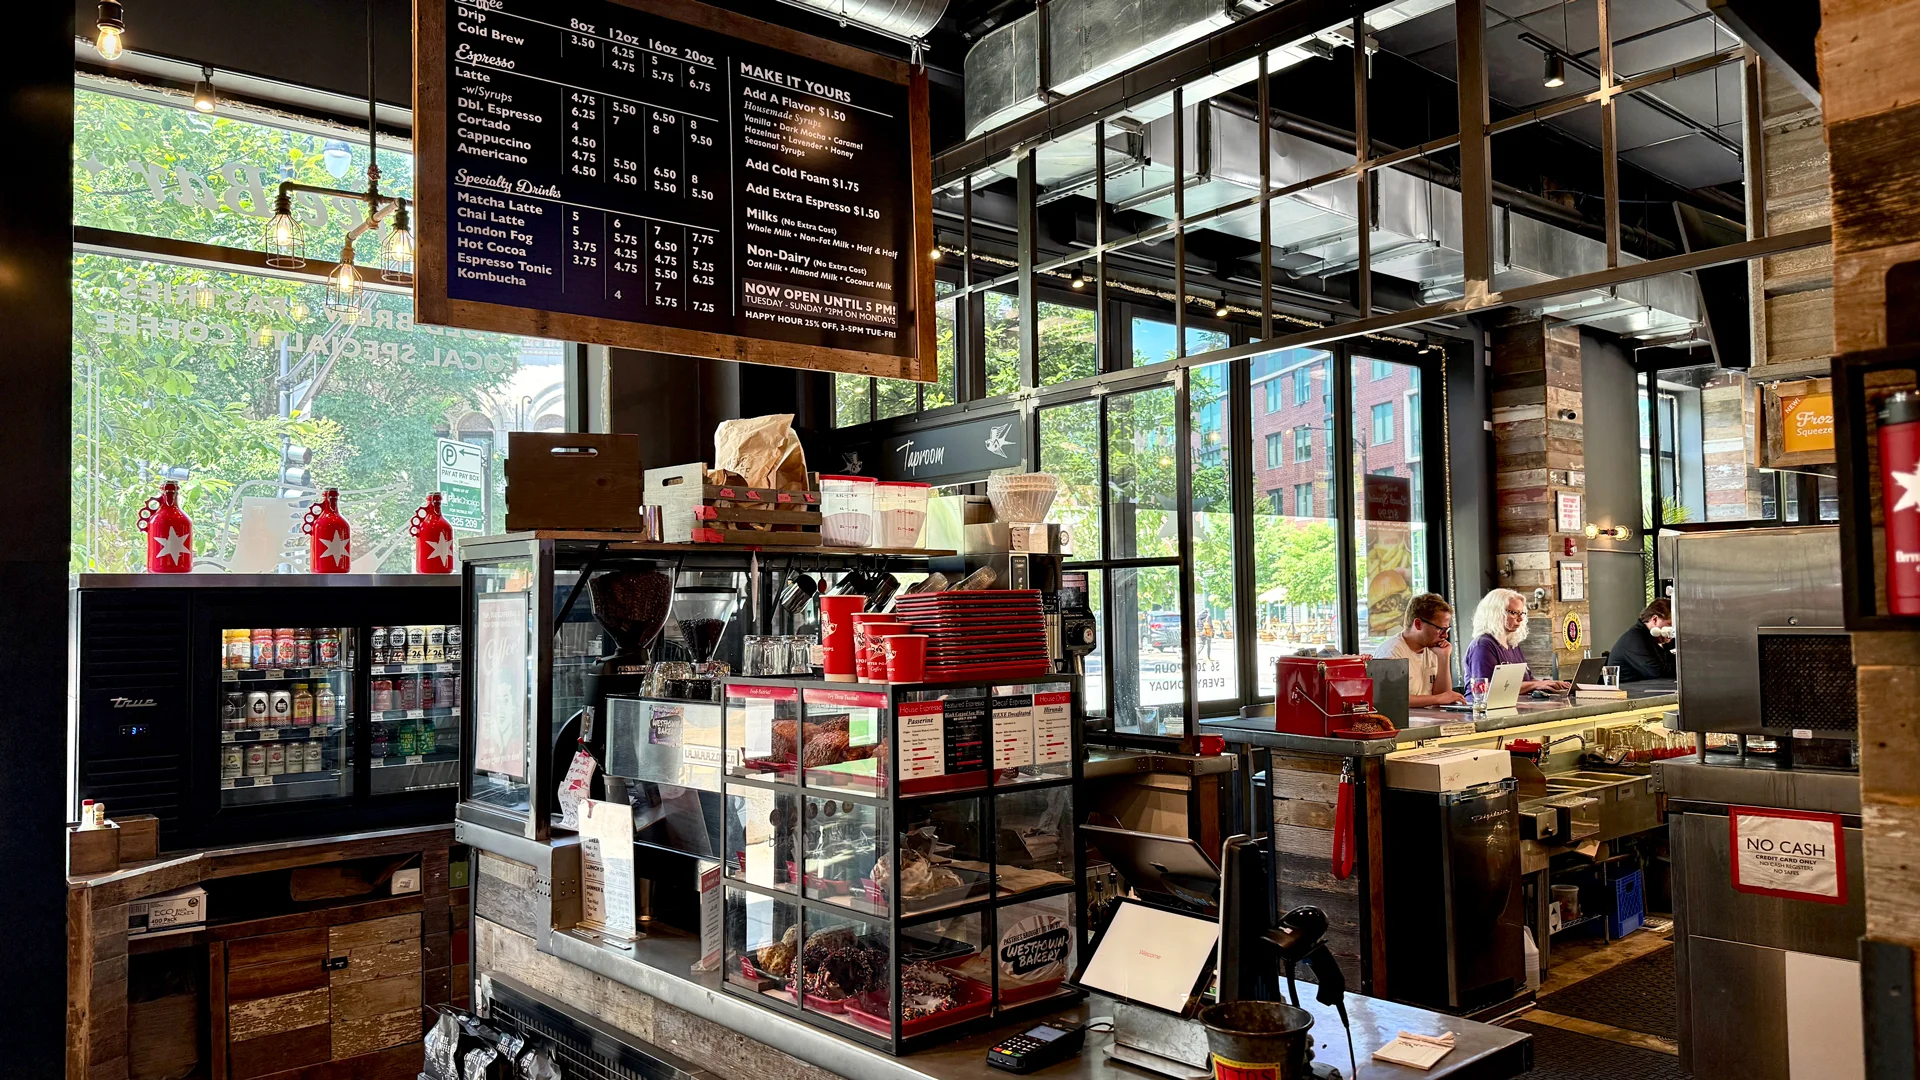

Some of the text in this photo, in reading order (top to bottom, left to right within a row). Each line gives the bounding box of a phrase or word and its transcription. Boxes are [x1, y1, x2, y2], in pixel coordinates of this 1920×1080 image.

[458, 6, 486, 23] Drip
[457, 21, 524, 45] Cold Brew
[570, 17, 714, 65] 8oz 12oz 16oz 20oz
[455, 43, 514, 70] Espresso
[455, 66, 490, 82] Latte
[740, 62, 850, 102] MAKE IT YOURS
[461, 85, 512, 103] -w/Syrups
[743, 86, 845, 121] Add A Flavor $1.50
[457, 112, 510, 131] Cortado
[458, 97, 542, 123] Dbl. Espresso
[743, 100, 822, 129] Housemade Syrups
[457, 127, 531, 149] Cappuccino
[744, 113, 863, 150] Vanilla Dark Mocha Caramel
[744, 124, 853, 159] Hazelnut Lavender Honey
[457, 142, 527, 164] Americano
[744, 135, 805, 157] Seasonal Syrups
[455, 168, 561, 198] Specialty Drinks
[745, 158, 859, 192] Add Cold Foam $1.75
[458, 191, 542, 214] Matcha Latte
[745, 182, 879, 219] Add Extra Espresso $1.50
[457, 207, 524, 226] Chai Latte
[746, 206, 836, 236] Milks (No Extra Cost)
[458, 221, 533, 245] London Fog
[746, 222, 898, 259] Whole Milk Non-Fat Milk Half Half
[458, 237, 526, 256] Hot Cocoa
[458, 252, 552, 275] Espresso Tonic
[747, 243, 866, 276] Non-Dairy (No Extra Cost)
[458, 267, 526, 286] Kombucha
[747, 259, 891, 290] Oat Milk Almond Milk Coconut Milk
[744, 294, 895, 324] TUESDAY SUNDAY ON MONDAYS
[745, 282, 895, 315] NOW OPEN UNTIL 5 PM!
[745, 310, 896, 338] HAPPY HOUR 25% OFF, 3-5PM TUE-FRI
[1785, 397, 1801, 414] NEW!
[896, 439, 945, 477] Taproom
[442, 469, 451, 477] PAY
[459, 472, 468, 480] PAY
[451, 517, 478, 528] 325 209
[110, 697, 158, 708] true
[992, 698, 1031, 707] Decaf Espresso
[907, 717, 934, 725] Passerine
[1746, 837, 1826, 857] NO CASH
[1755, 854, 1778, 862] CREDIT
[1003, 933, 1023, 946] PASTRIES
[1019, 948, 1060, 967] BAKERY
